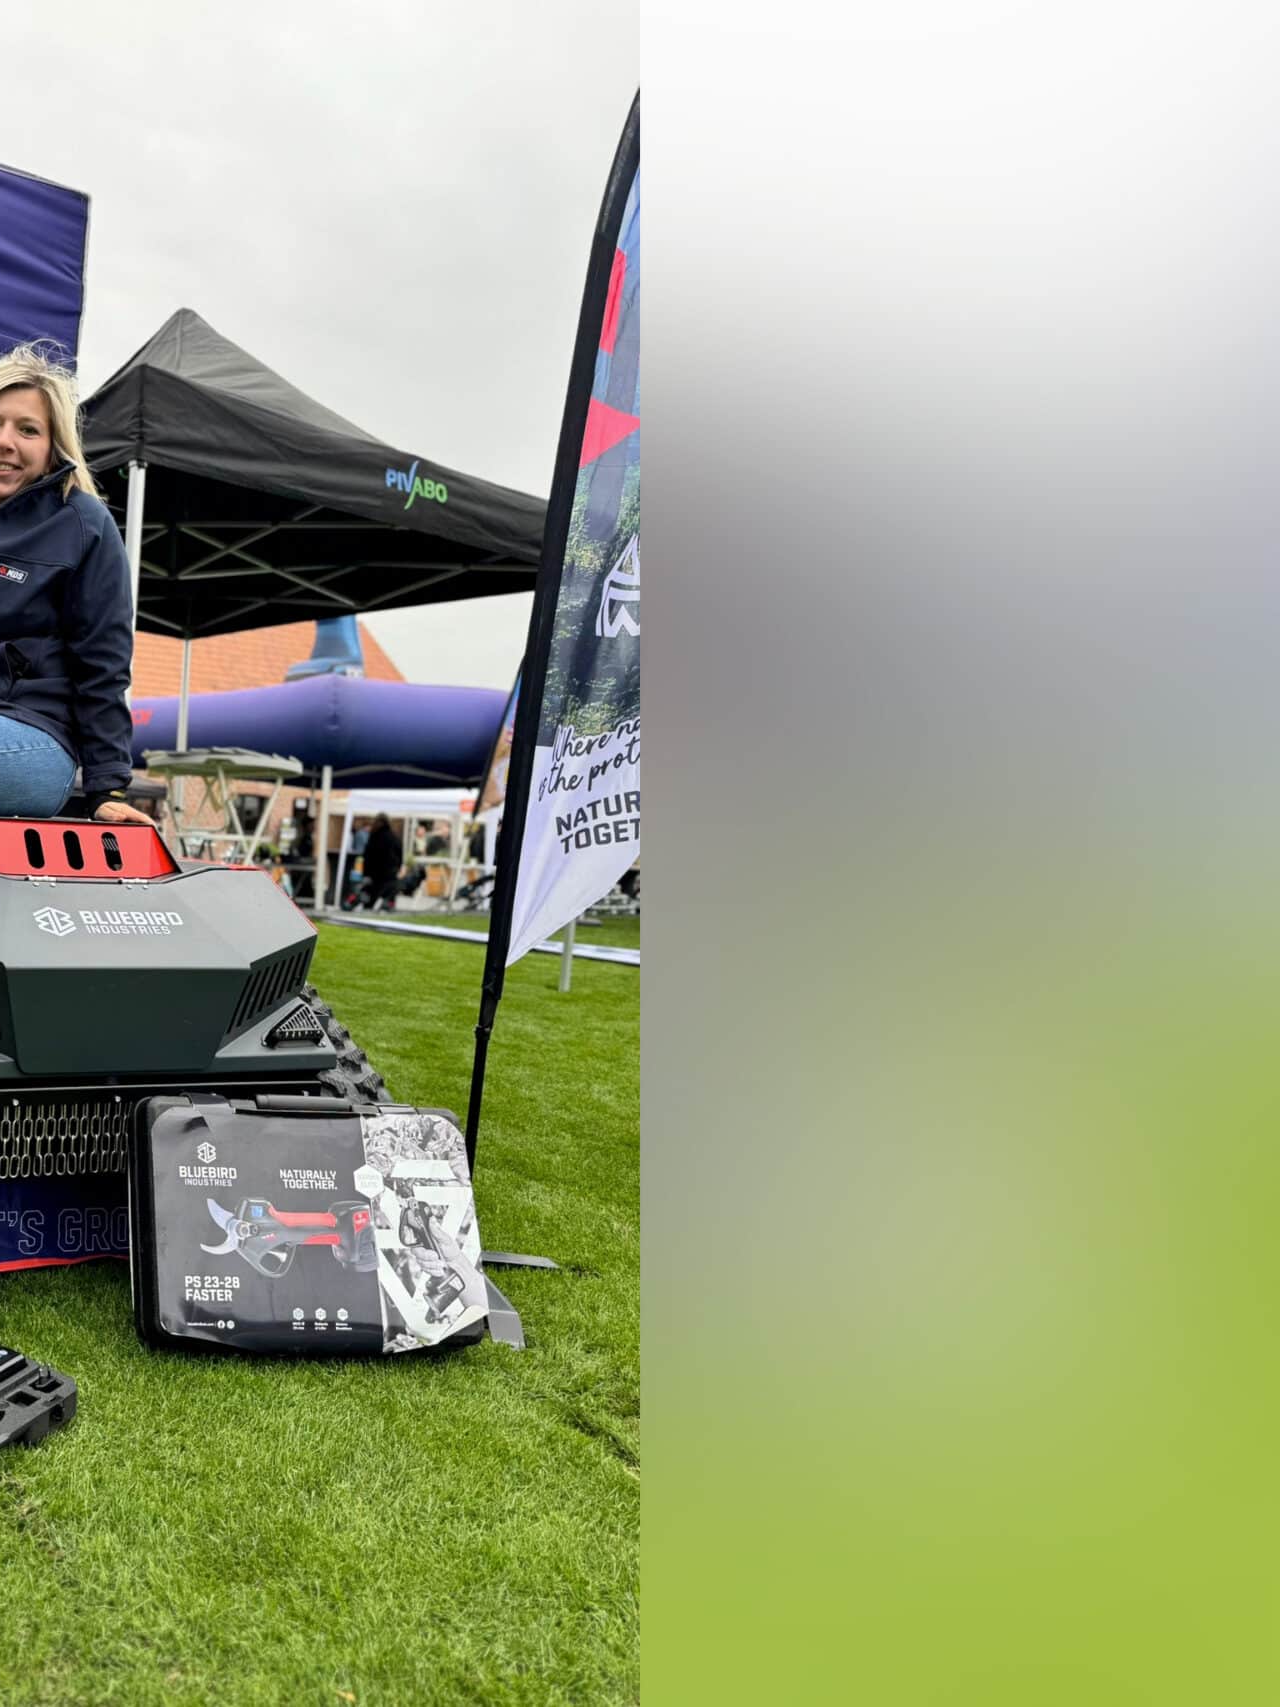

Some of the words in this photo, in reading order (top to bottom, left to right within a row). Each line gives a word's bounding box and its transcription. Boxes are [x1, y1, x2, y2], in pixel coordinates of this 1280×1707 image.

[385, 460, 448, 510] PIVABO
[548, 762, 584, 794] the
[78, 910, 184, 926] BLUEBIRD
[86, 925, 172, 936] INDUSTRIES
[178, 1165, 238, 1180] BLUEBIRD
[279, 1169, 337, 1181] NATURALLY
[184, 1178, 233, 1187] INDUSTRIES
[282, 1179, 338, 1190] TOGETHER.
[184, 1275, 202, 1288] PS
[204, 1276, 240, 1289] 23-28
[185, 1289, 233, 1302] FASTER
